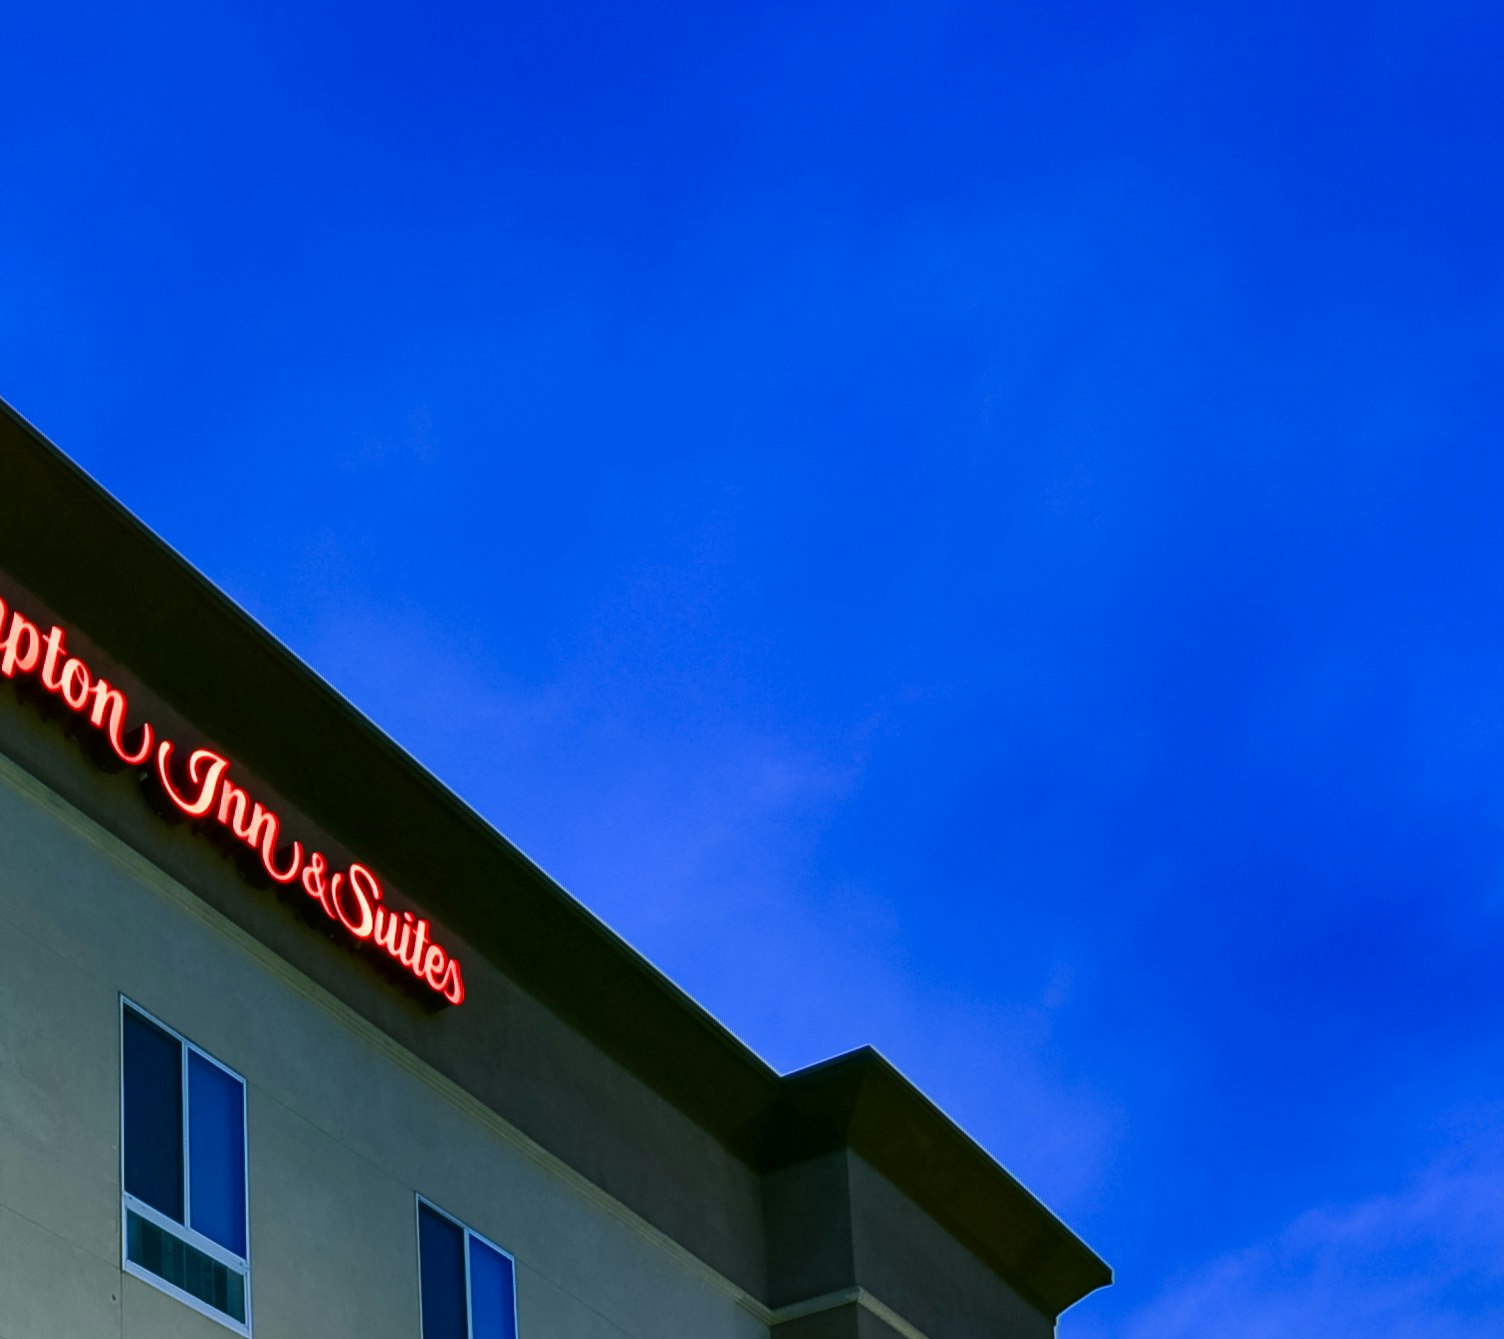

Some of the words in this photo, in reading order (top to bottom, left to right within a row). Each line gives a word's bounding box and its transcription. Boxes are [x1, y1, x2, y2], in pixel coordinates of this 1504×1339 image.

[157, 740, 300, 882] Inn
[301, 852, 335, 919] &
[330, 862, 465, 1005] Suites
